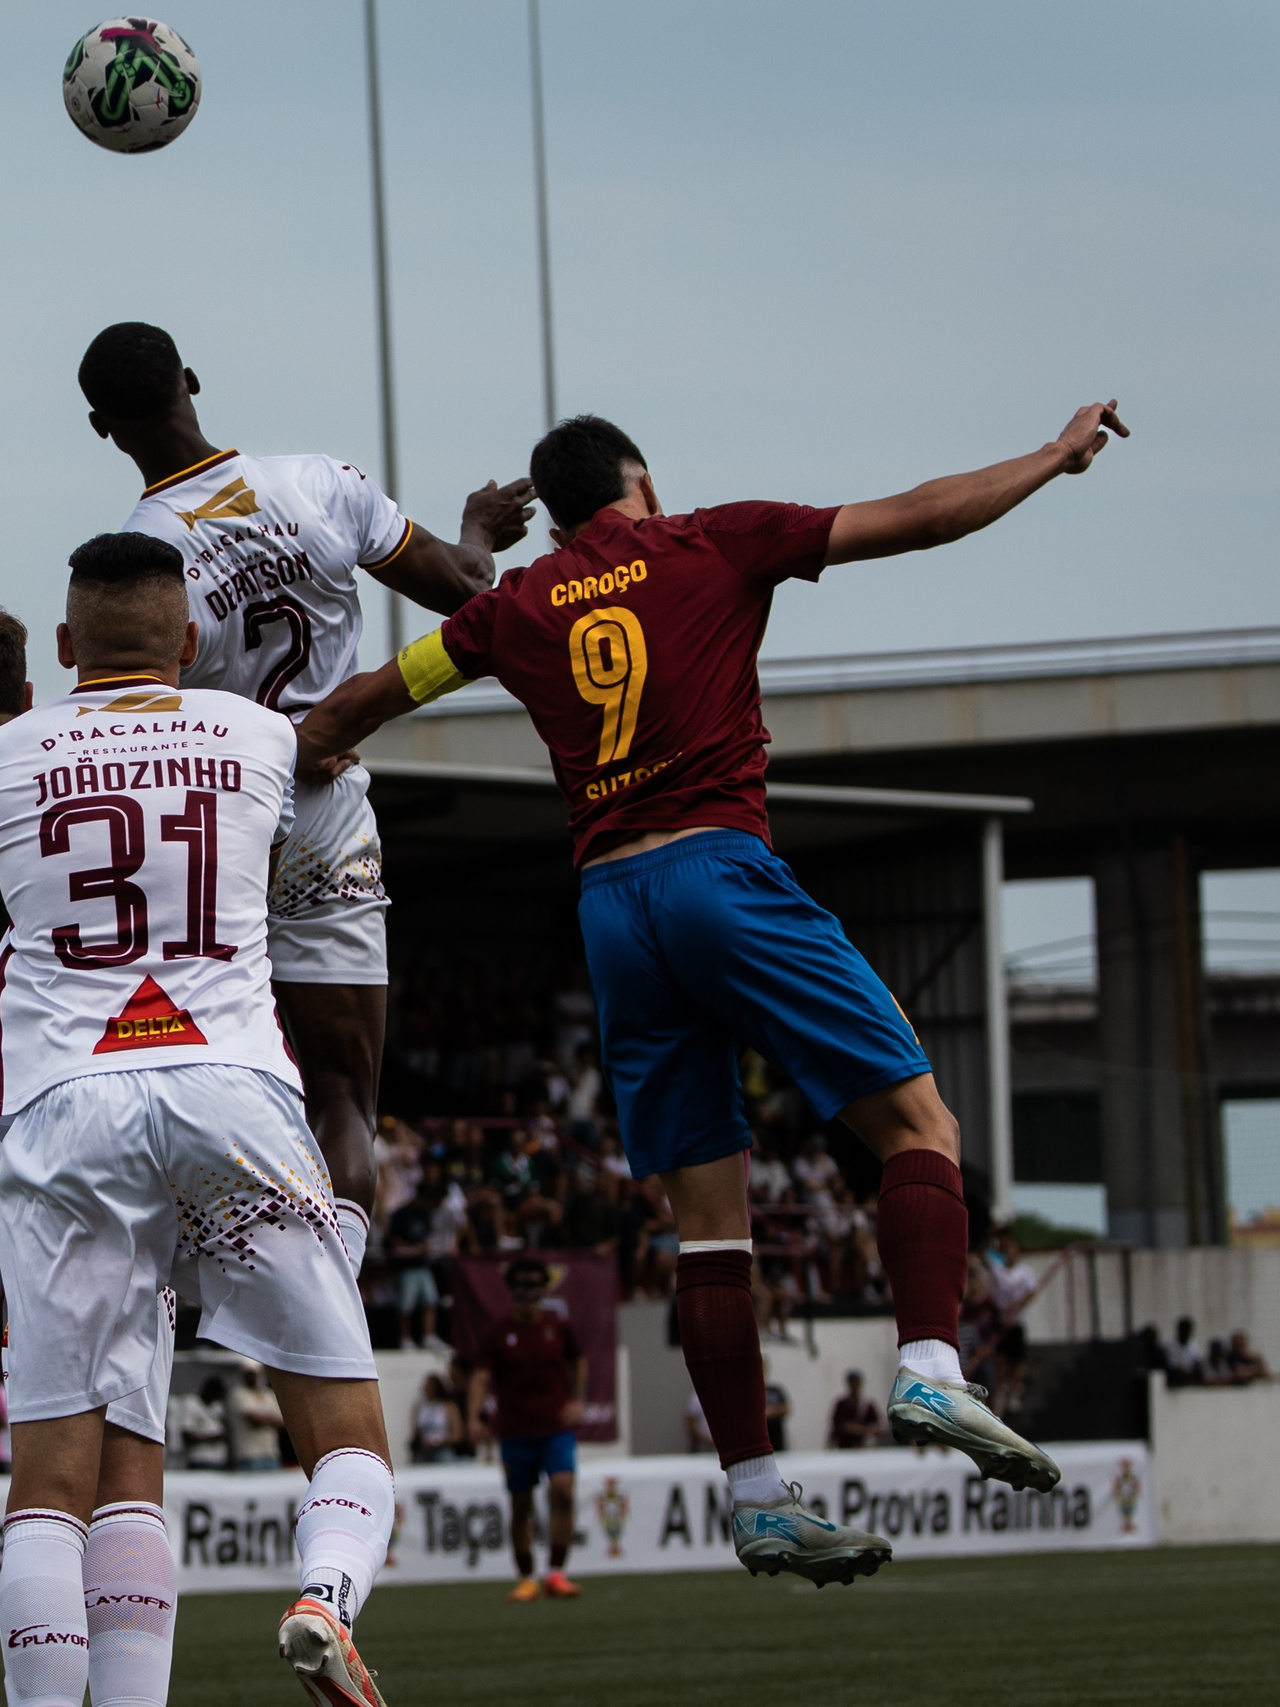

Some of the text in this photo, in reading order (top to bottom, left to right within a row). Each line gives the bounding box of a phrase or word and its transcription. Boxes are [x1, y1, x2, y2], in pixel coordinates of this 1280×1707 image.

[187, 523, 299, 581] D'BACALHAU
[551, 559, 648, 607] CAROÇO
[243, 594, 317, 714] 2
[569, 606, 648, 766] 9
[40, 720, 229, 752] D'BACALHAU
[82, 741, 189, 756] RESTAURANTE
[32, 756, 242, 807] JOÃOZINHO
[38, 790, 238, 971] 31
[116, 1015, 186, 1039] DELTA
[415, 1489, 504, 1567] Taça
[659, 1481, 692, 1548] A
[840, 1473, 950, 1538] Prova
[85, 1594, 172, 1611] LAYOFF
[22, 1632, 90, 1651] PLAYOF
